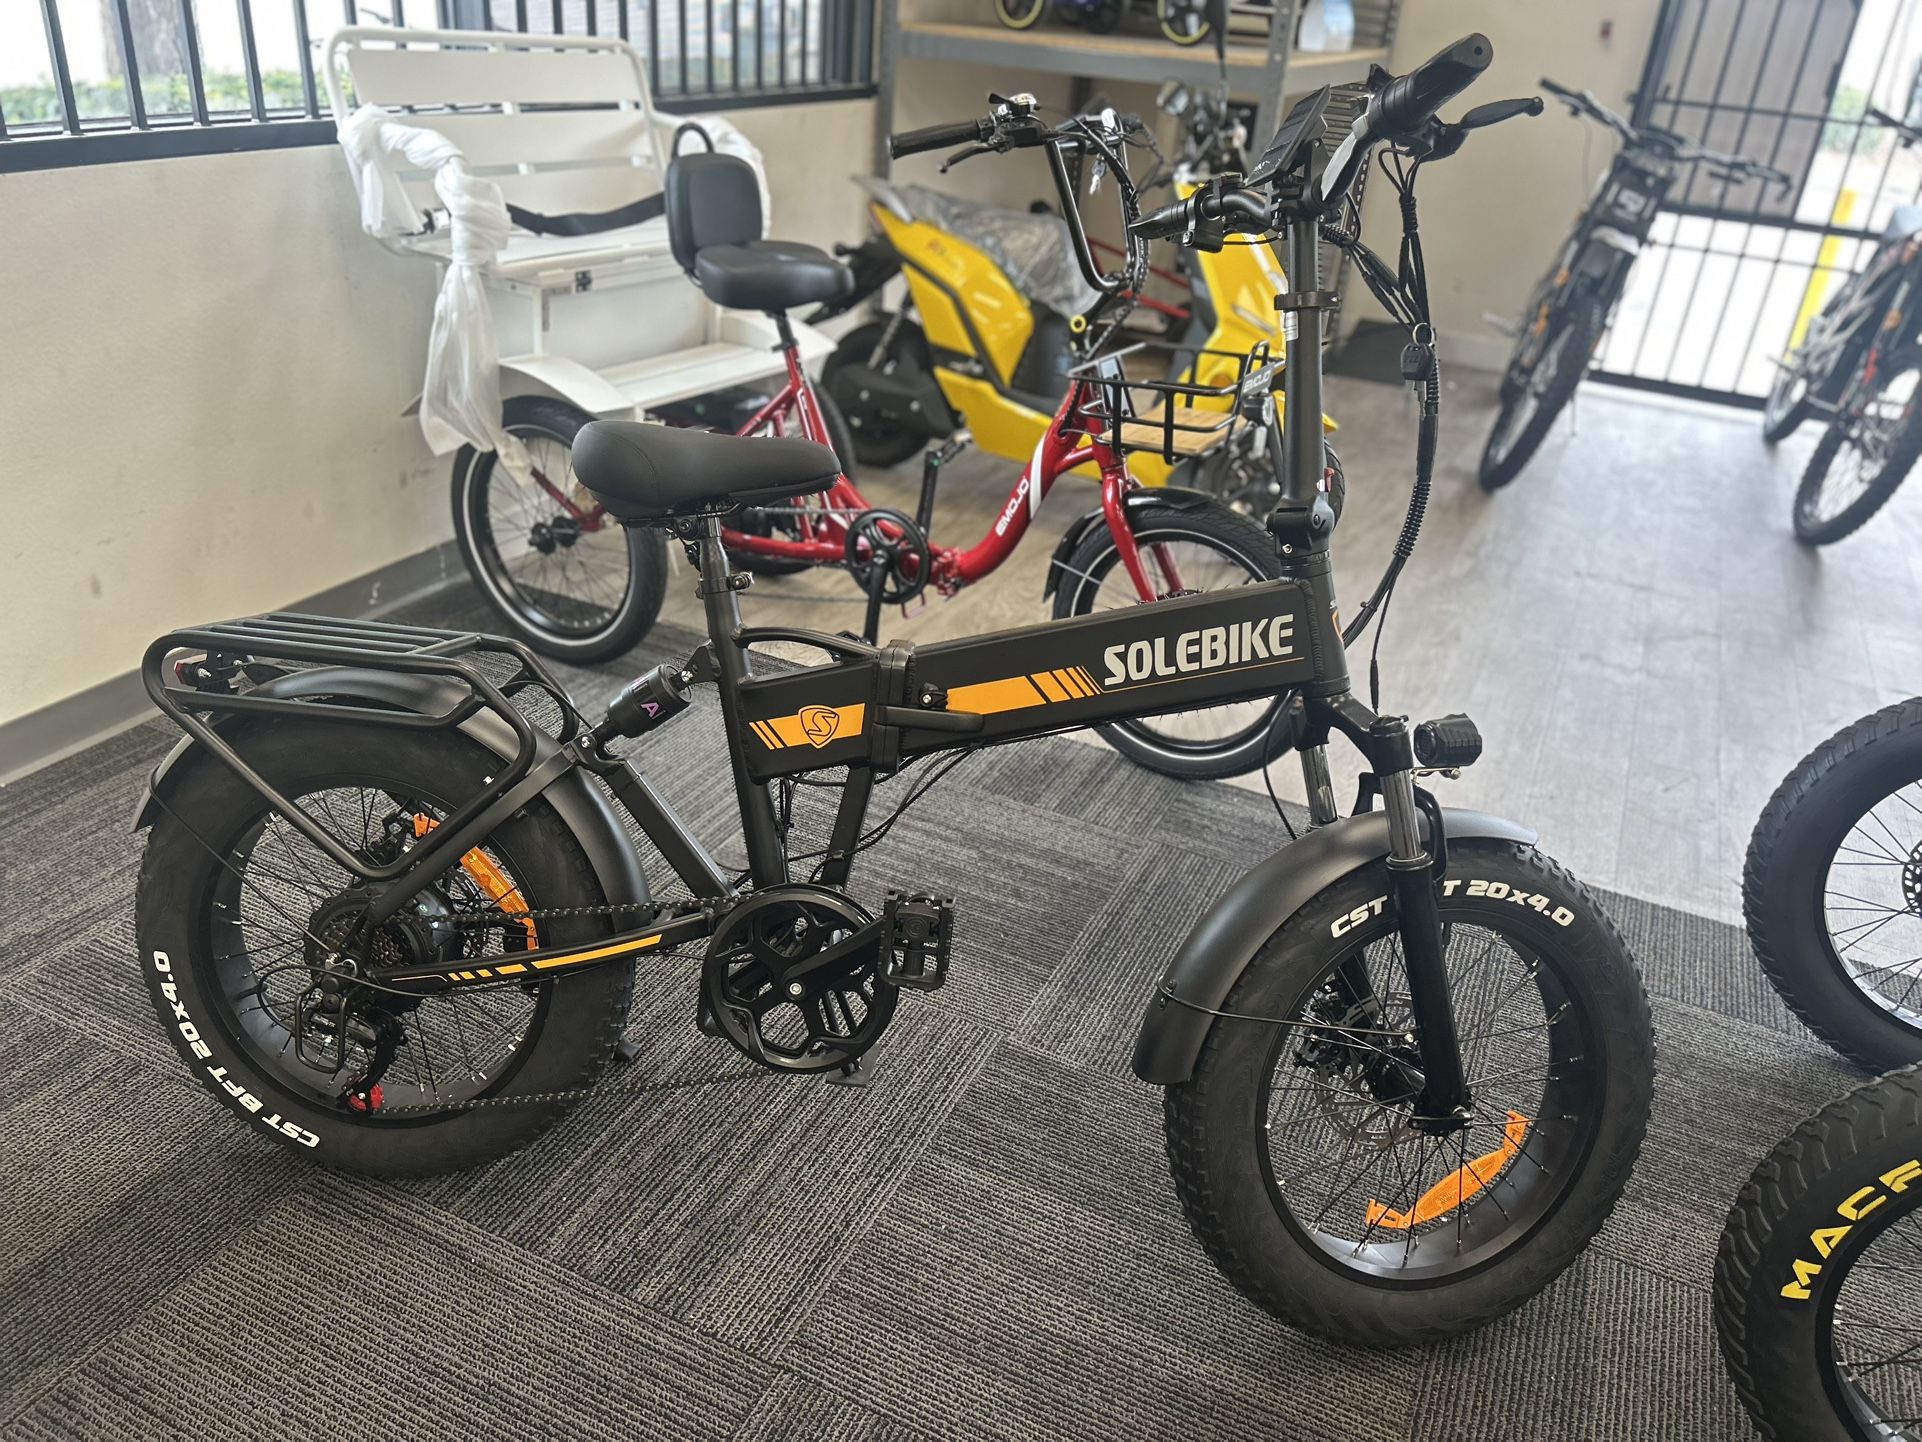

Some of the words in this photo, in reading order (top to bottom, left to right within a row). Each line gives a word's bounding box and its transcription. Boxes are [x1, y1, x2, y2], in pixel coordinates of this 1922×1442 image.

[995, 475, 1030, 537] EMOJO
[1103, 613, 1294, 686] SOLEBIKE
[1330, 895, 1388, 938] CST
[1466, 880, 1576, 927] 20x4.0
[153, 950, 213, 1060] 20x4.0
[206, 1065, 264, 1114] BFT
[261, 1113, 321, 1149] CST
